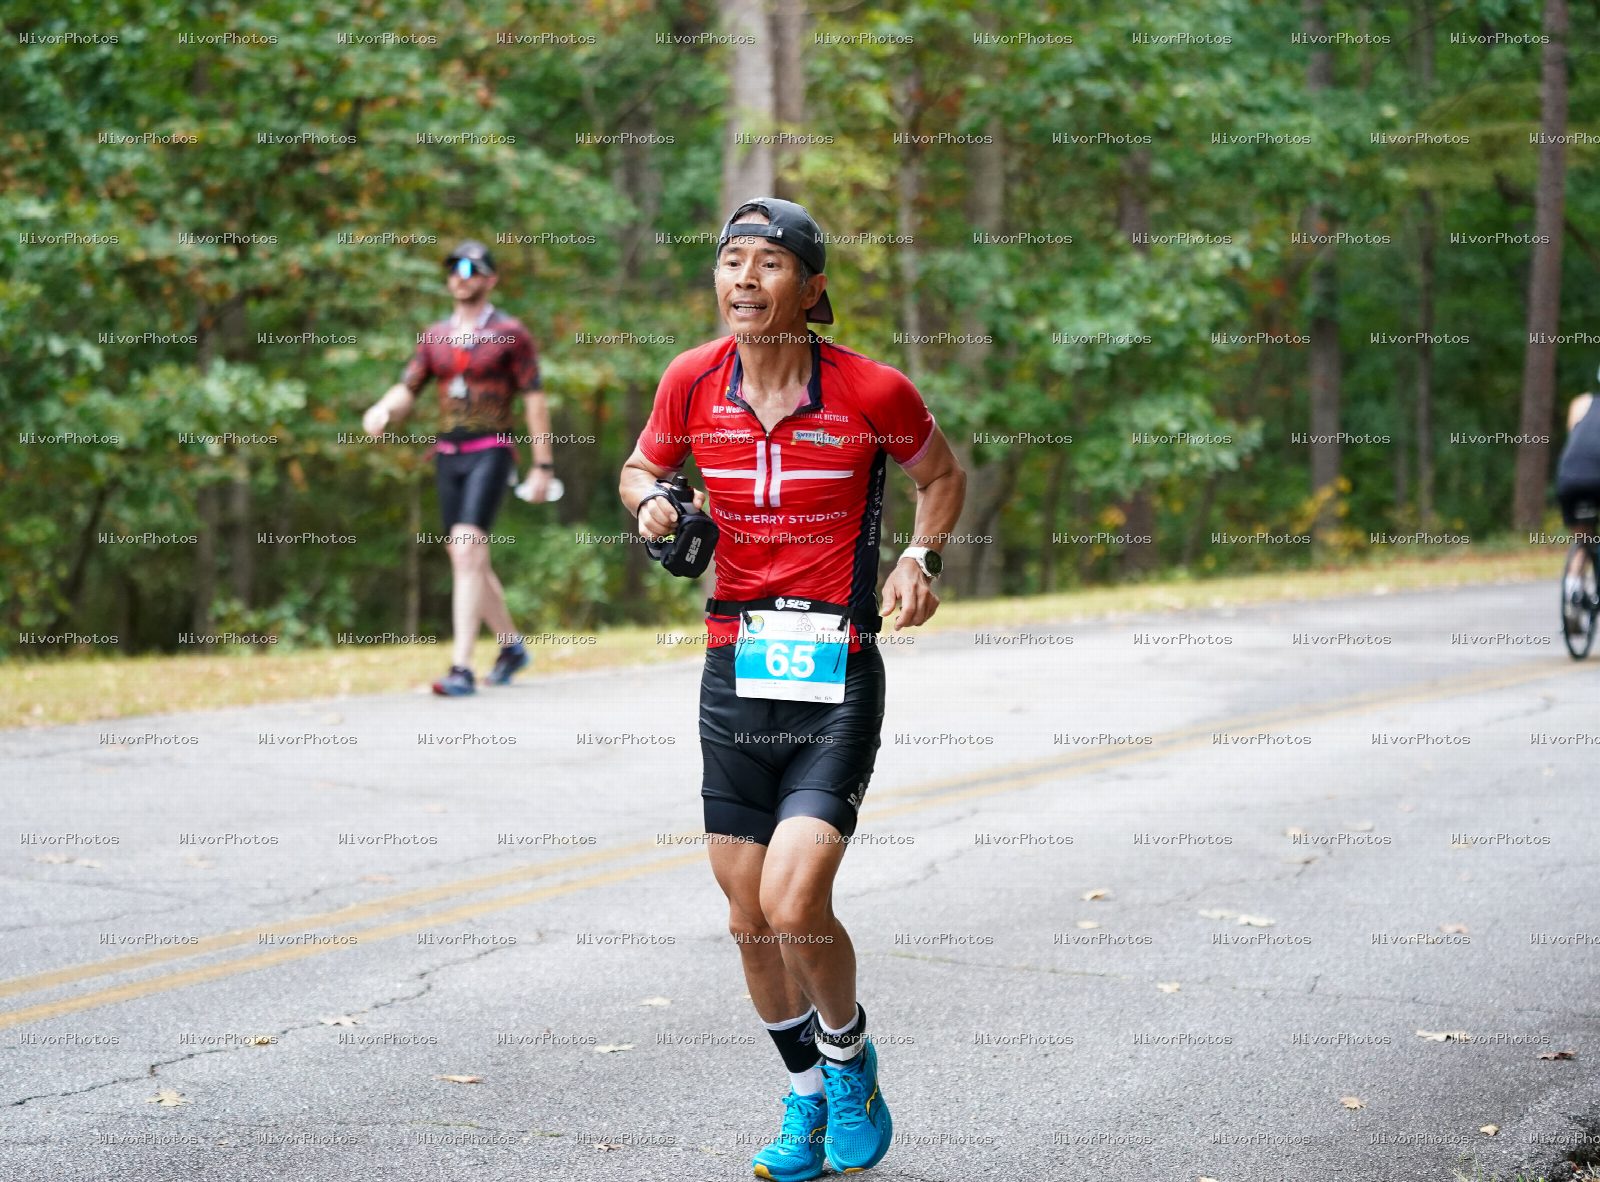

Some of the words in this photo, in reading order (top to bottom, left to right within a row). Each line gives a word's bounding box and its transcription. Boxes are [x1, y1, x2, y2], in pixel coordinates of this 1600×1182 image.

[824, 413, 849, 422] BICYCLES
[744, 514, 785, 524] PERRY
[788, 511, 848, 524] STUDIOS
[765, 642, 816, 678] 65
